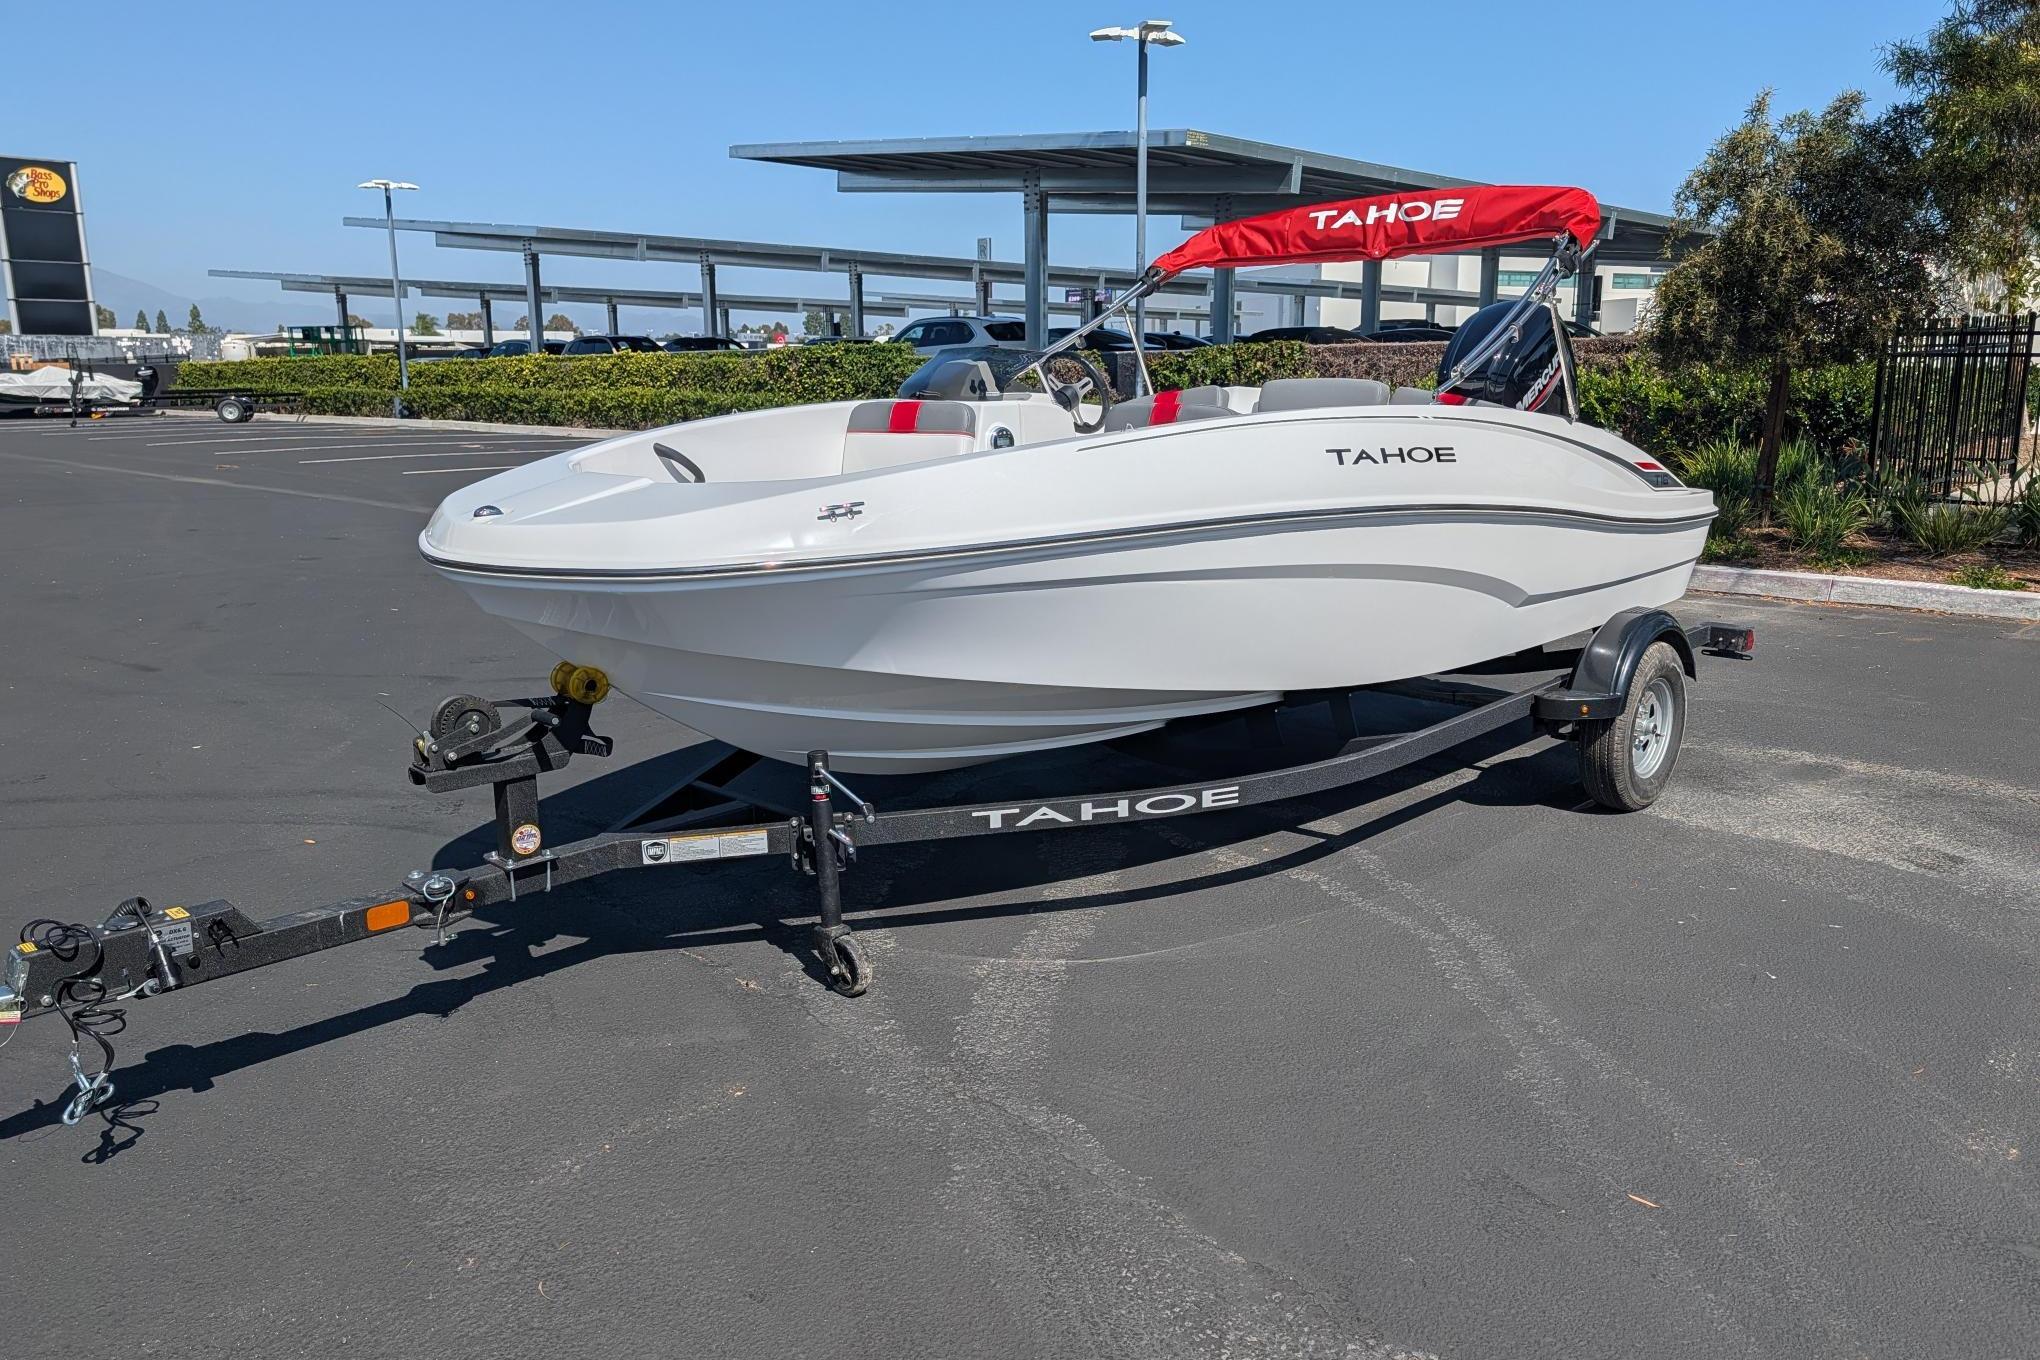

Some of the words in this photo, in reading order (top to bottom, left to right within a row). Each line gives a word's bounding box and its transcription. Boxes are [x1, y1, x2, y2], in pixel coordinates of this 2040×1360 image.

[31, 169, 52, 180] Bass
[32, 179, 49, 188] Pro
[33, 187, 60, 199] Shops
[1309, 198, 1465, 230] TAHOE
[1516, 351, 1561, 411] MERCUR
[1325, 446, 1457, 466] TAHOE
[971, 785, 1240, 829] TAHOE
